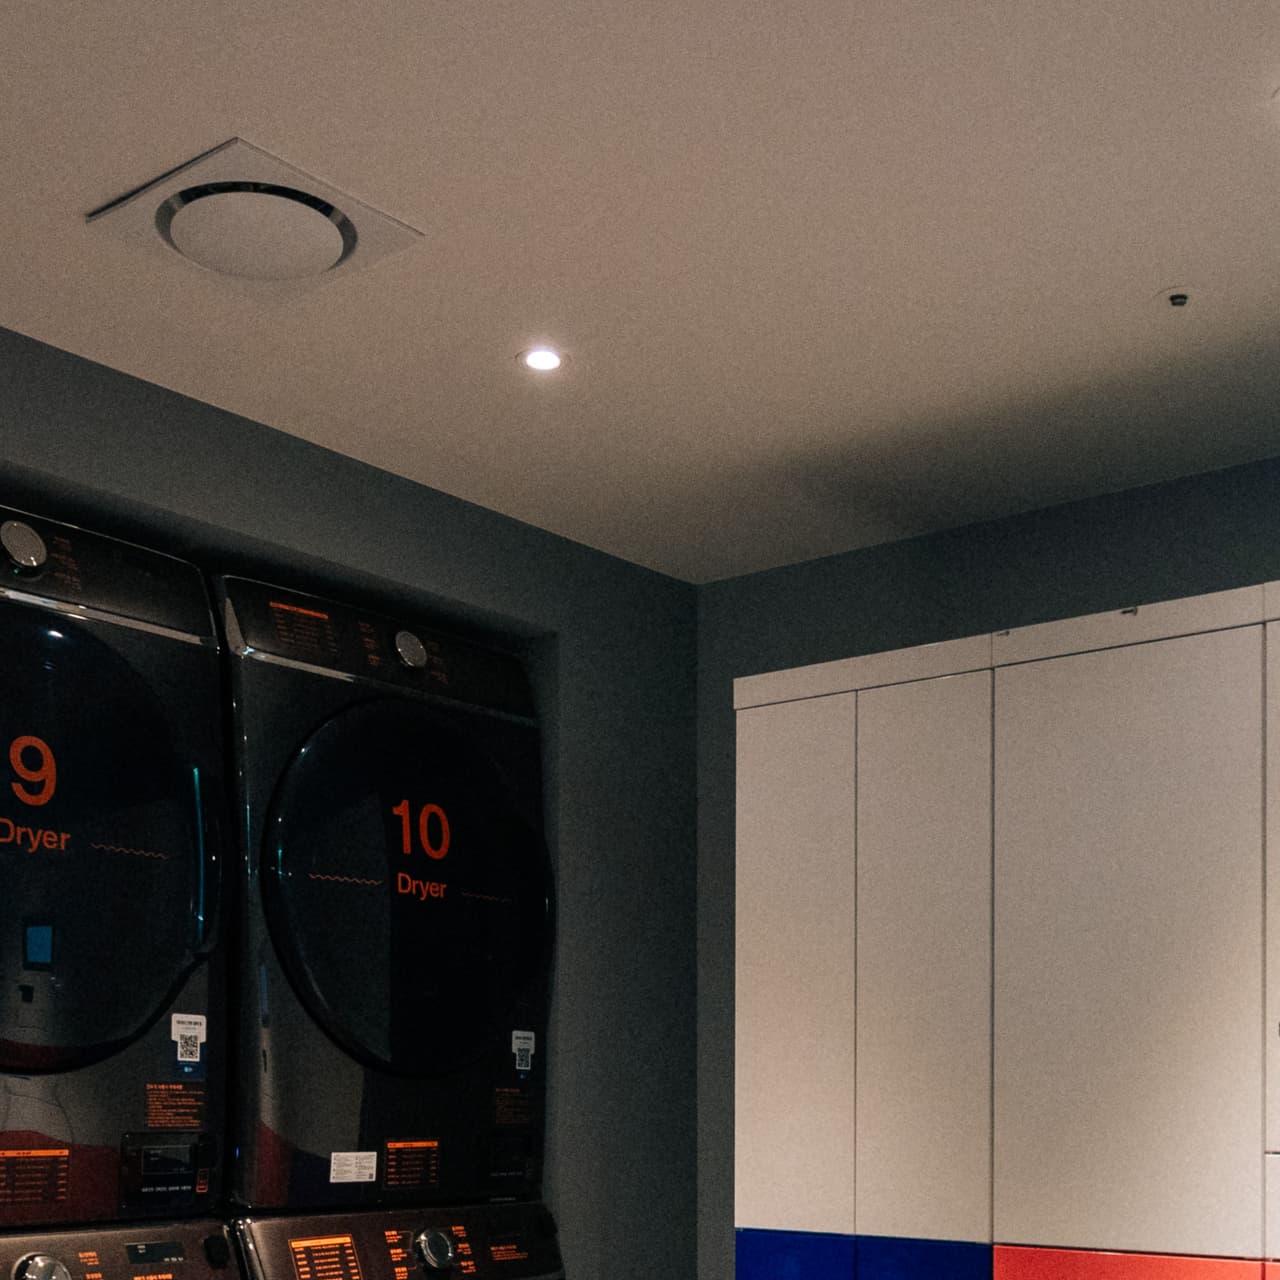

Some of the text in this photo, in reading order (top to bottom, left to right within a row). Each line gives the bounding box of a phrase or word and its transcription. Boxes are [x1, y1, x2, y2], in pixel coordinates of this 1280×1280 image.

[9, 735, 57, 806] 9
[392, 799, 451, 860] 10
[397, 872, 447, 901] Dryer
